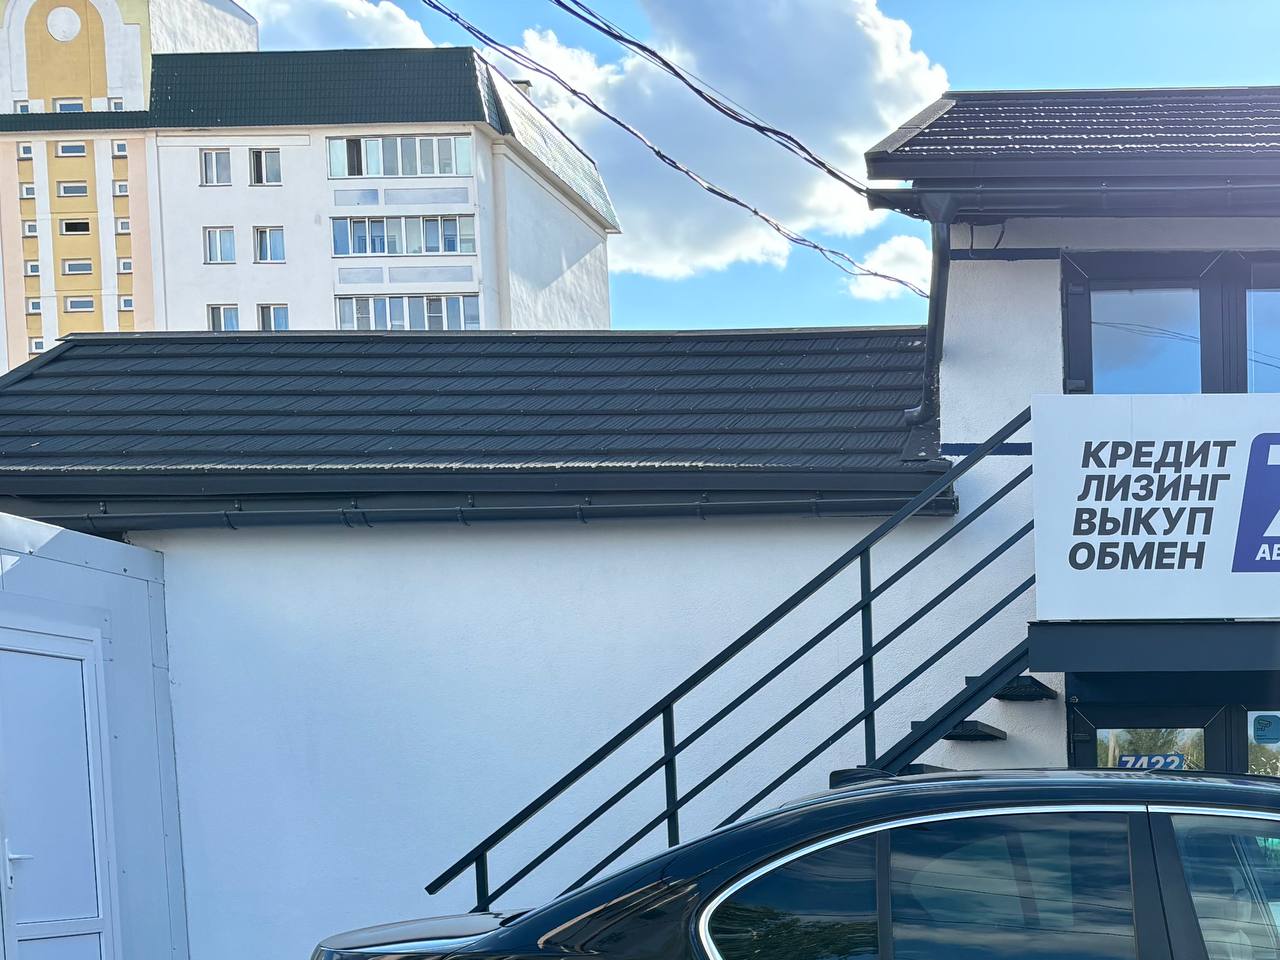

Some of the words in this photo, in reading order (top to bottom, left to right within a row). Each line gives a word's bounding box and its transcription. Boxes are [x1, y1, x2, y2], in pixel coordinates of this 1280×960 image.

[1081, 440, 1237, 474] КРЕДИТ
[1076, 474, 1231, 502] ЛИЗИНГ
[1072, 507, 1214, 536] ВЫКУП
[1068, 541, 1206, 571] ОБМЕН
